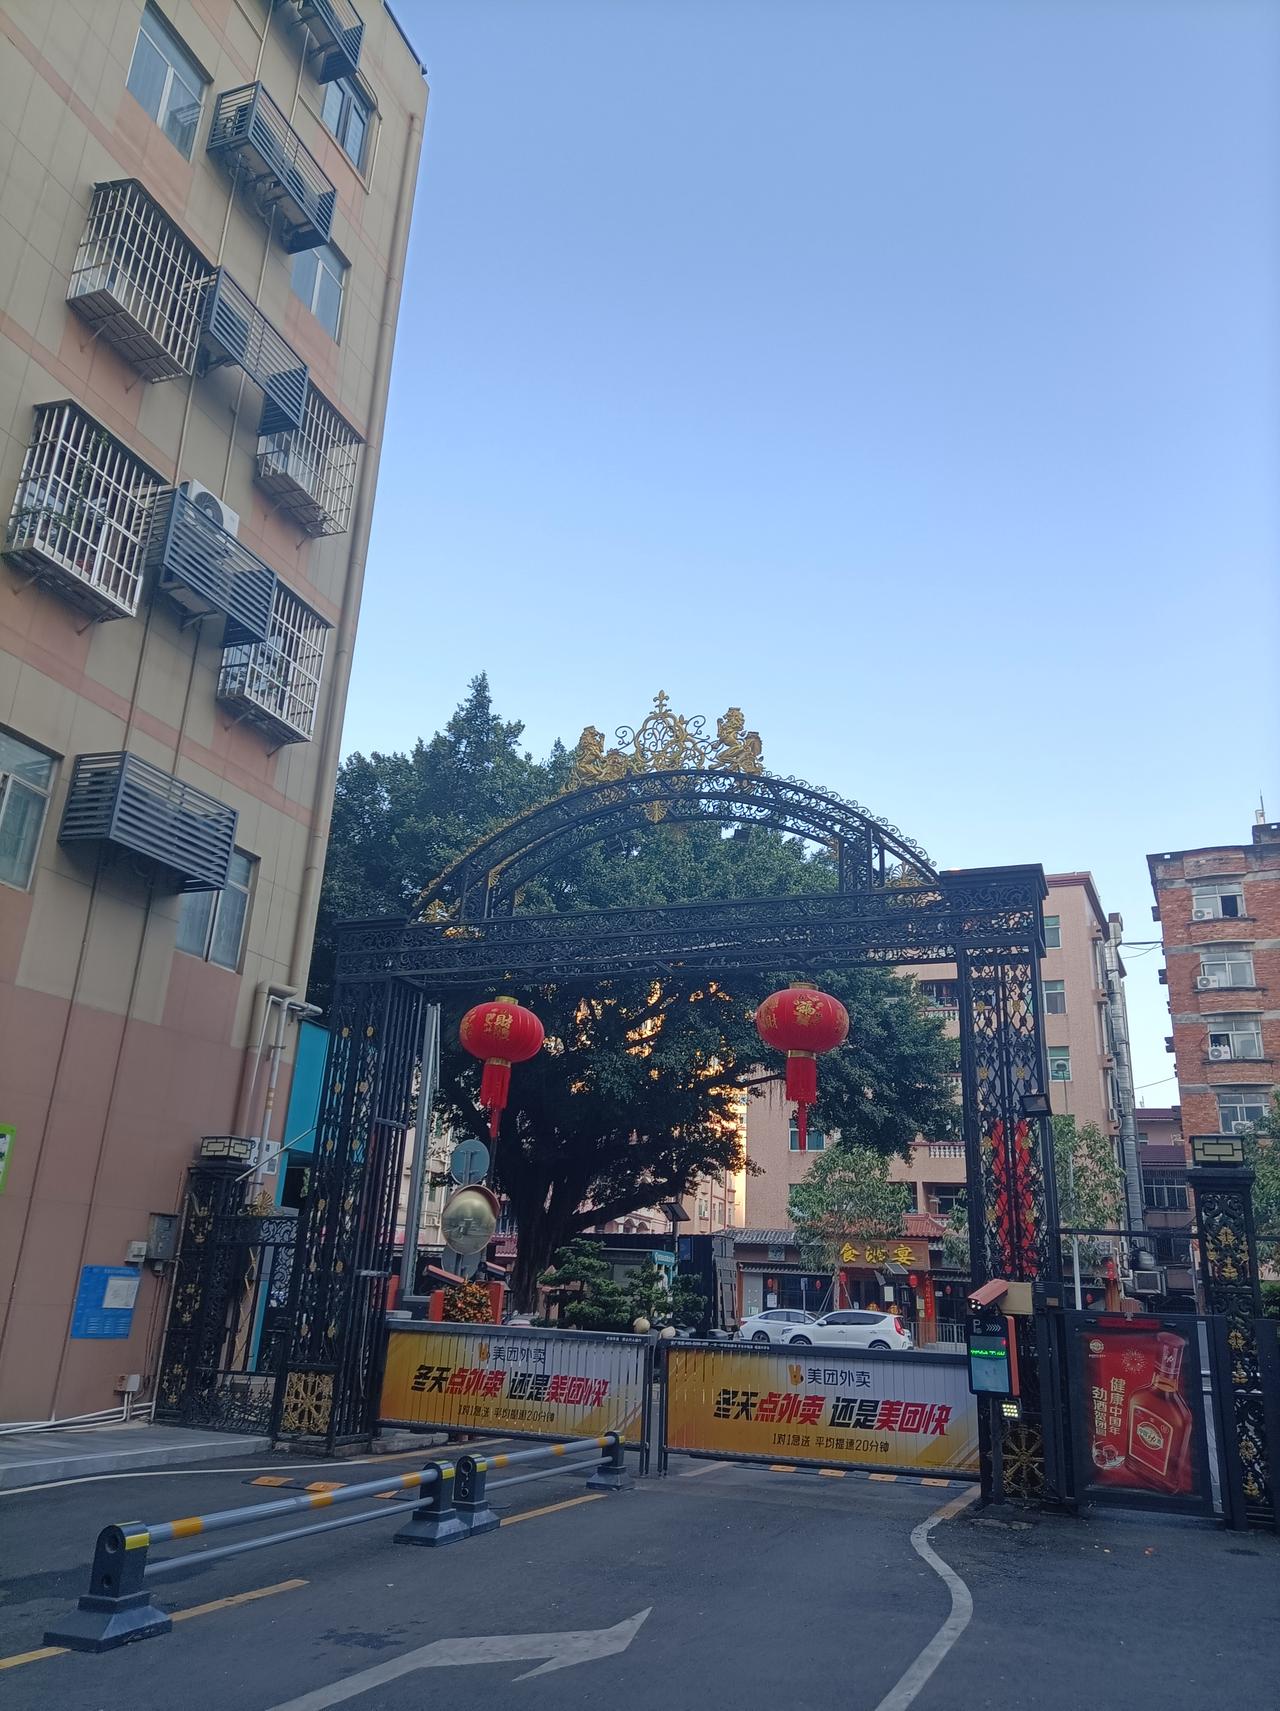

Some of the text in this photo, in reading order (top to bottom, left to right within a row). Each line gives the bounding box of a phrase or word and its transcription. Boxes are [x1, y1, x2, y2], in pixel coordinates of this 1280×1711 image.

[492, 1346, 545, 1364] 美团外卖
[411, 1364, 609, 1407] 冬天点外卖 还是美团快
[807, 1367, 871, 1388] 美团外卖
[713, 1388, 953, 1435] 冬天点外卖 还是美团快
[1109, 1377, 1126, 1436] 健康中国年
[772, 1433, 889, 1453] 1对1急送 平均提速20分钟
